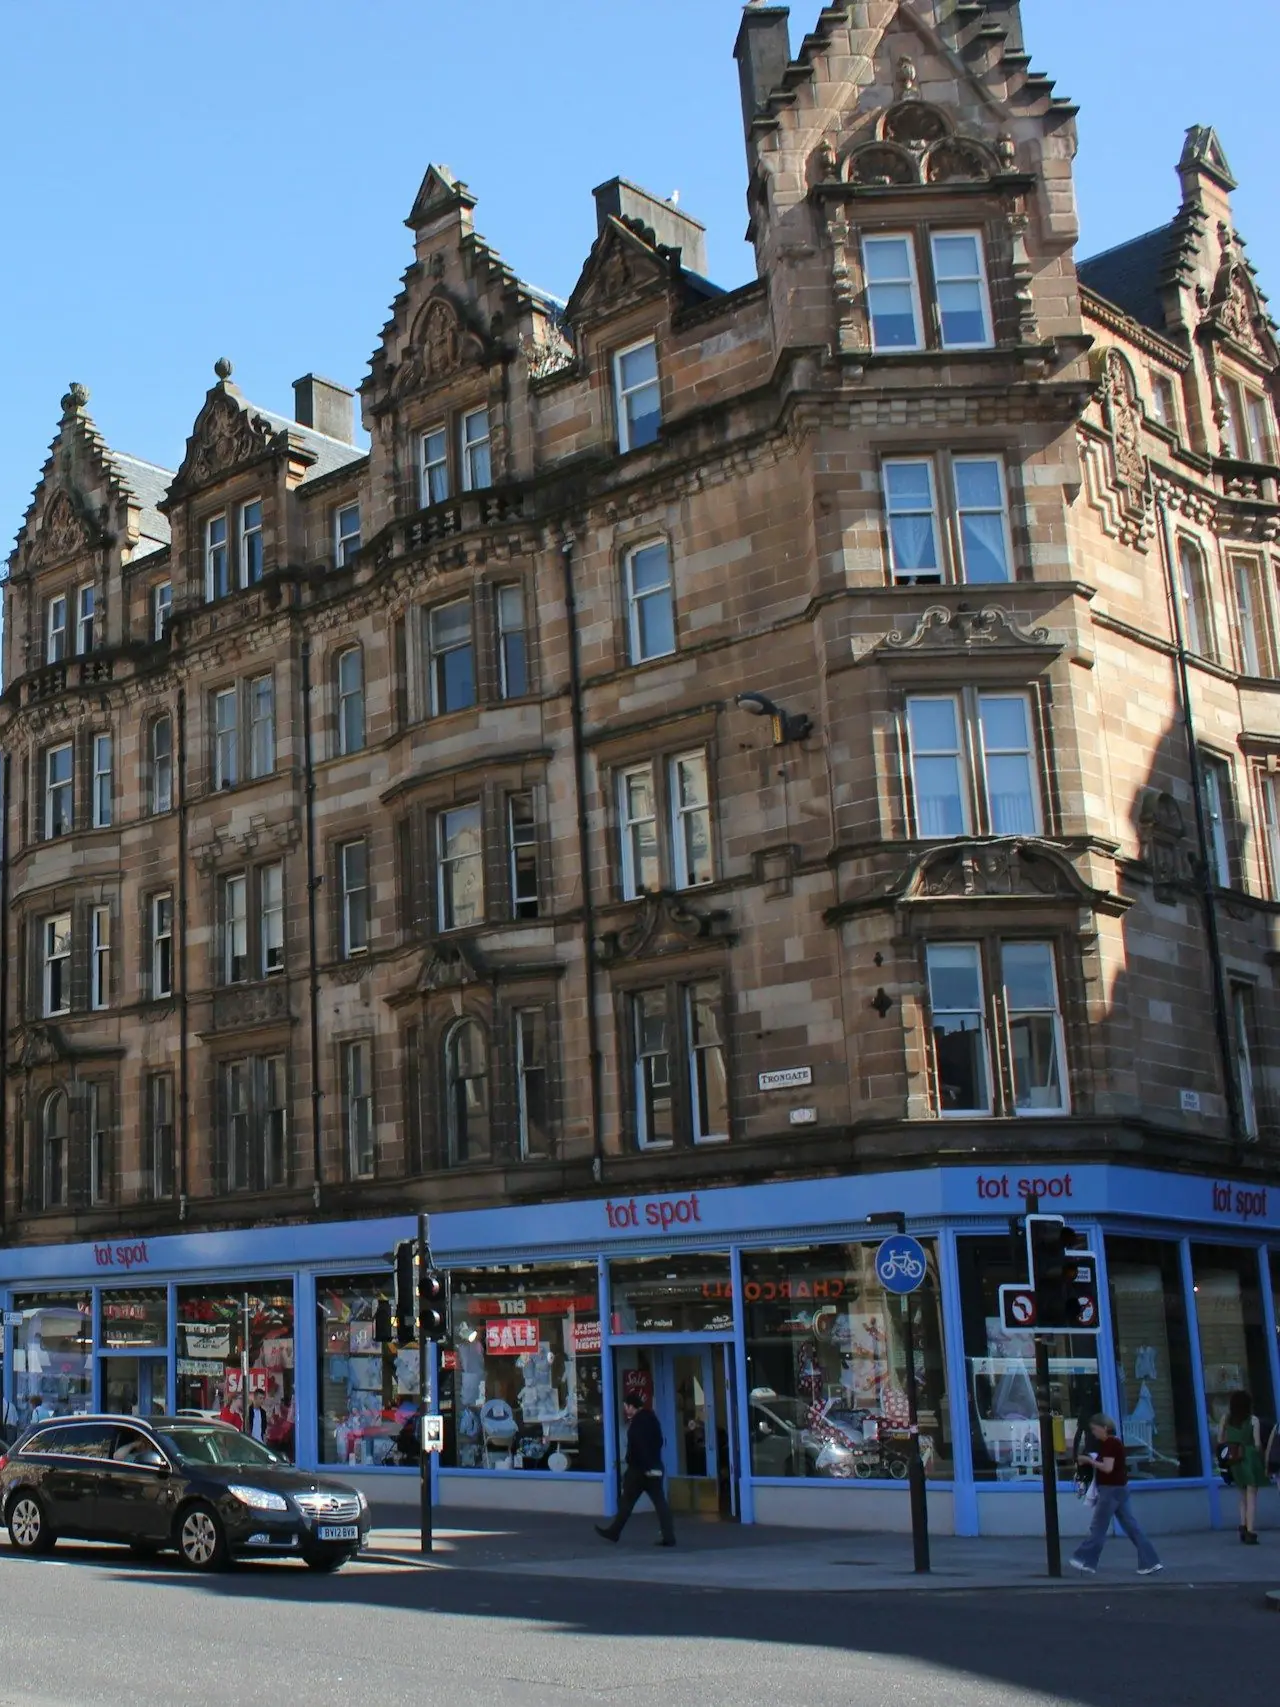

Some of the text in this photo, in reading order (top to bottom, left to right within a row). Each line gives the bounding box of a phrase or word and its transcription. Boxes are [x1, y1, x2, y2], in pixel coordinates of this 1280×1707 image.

[761, 1070, 809, 1083] TRONGATE
[977, 1172, 1072, 1198] tot spot
[606, 1193, 701, 1231] tot spot
[1213, 1181, 1267, 1222] tot spot
[94, 1240, 149, 1269] tot spot
[488, 1325, 536, 1347] SALE
